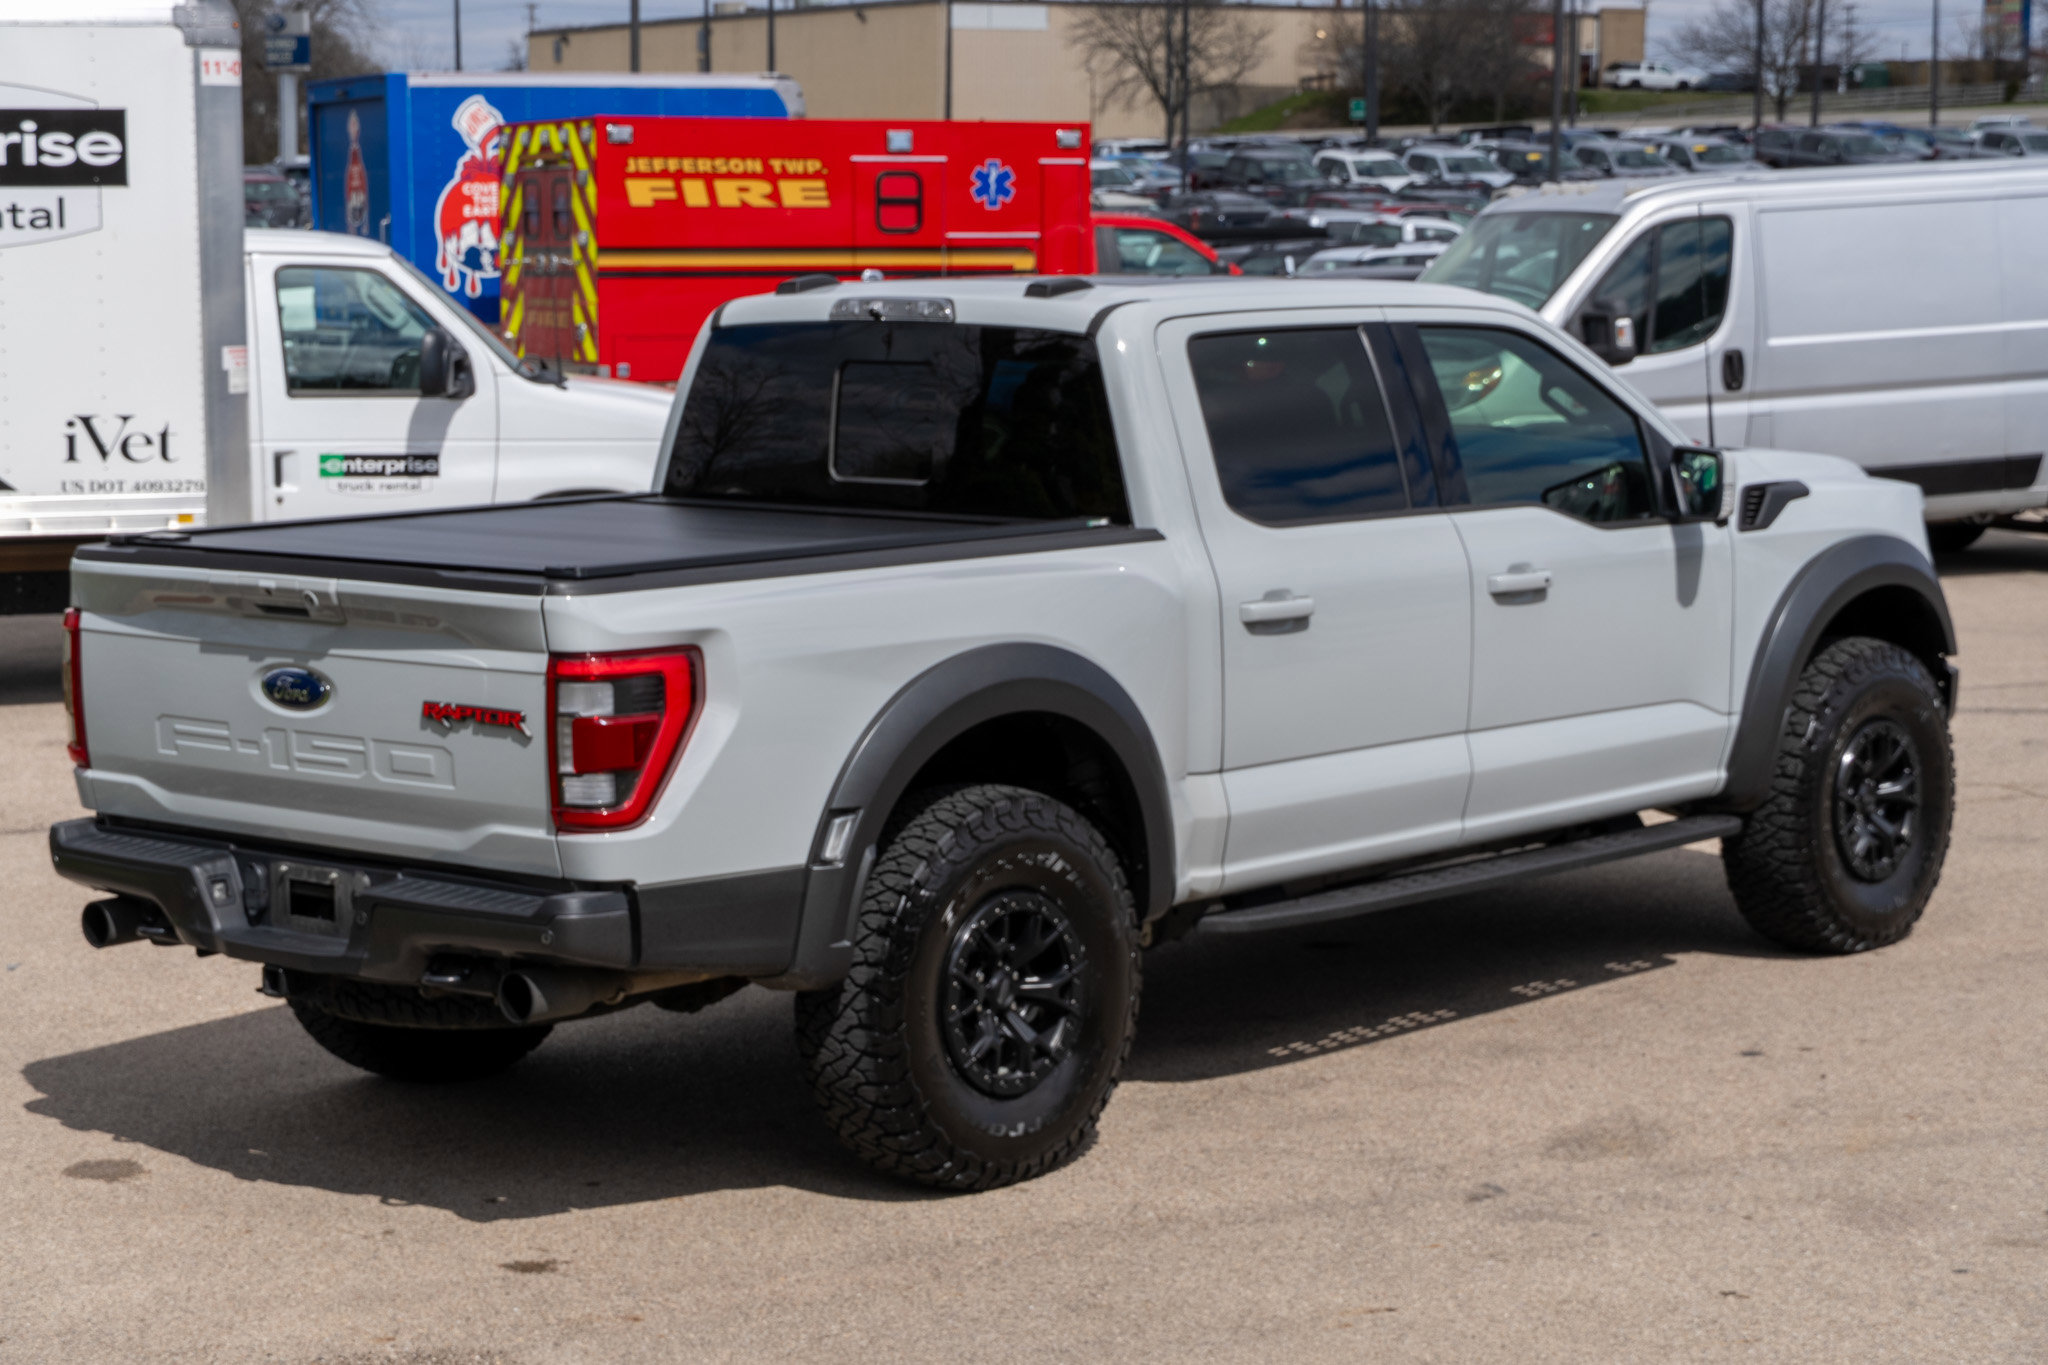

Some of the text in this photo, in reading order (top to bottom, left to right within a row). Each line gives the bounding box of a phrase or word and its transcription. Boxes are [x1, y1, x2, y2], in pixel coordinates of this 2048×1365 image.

[625, 156, 829, 175] JEFFERSON TWP.
[461, 181, 499, 196] COVE
[624, 177, 831, 208] FIRE
[462, 204, 498, 218] EART
[64, 414, 180, 463] iVet
[320, 457, 438, 476] enterprise
[61, 479, 84, 493] US
[89, 479, 126, 493] DOT
[337, 481, 373, 492] truck
[423, 701, 532, 737] RAPTOR
[155, 713, 456, 791] F-150
